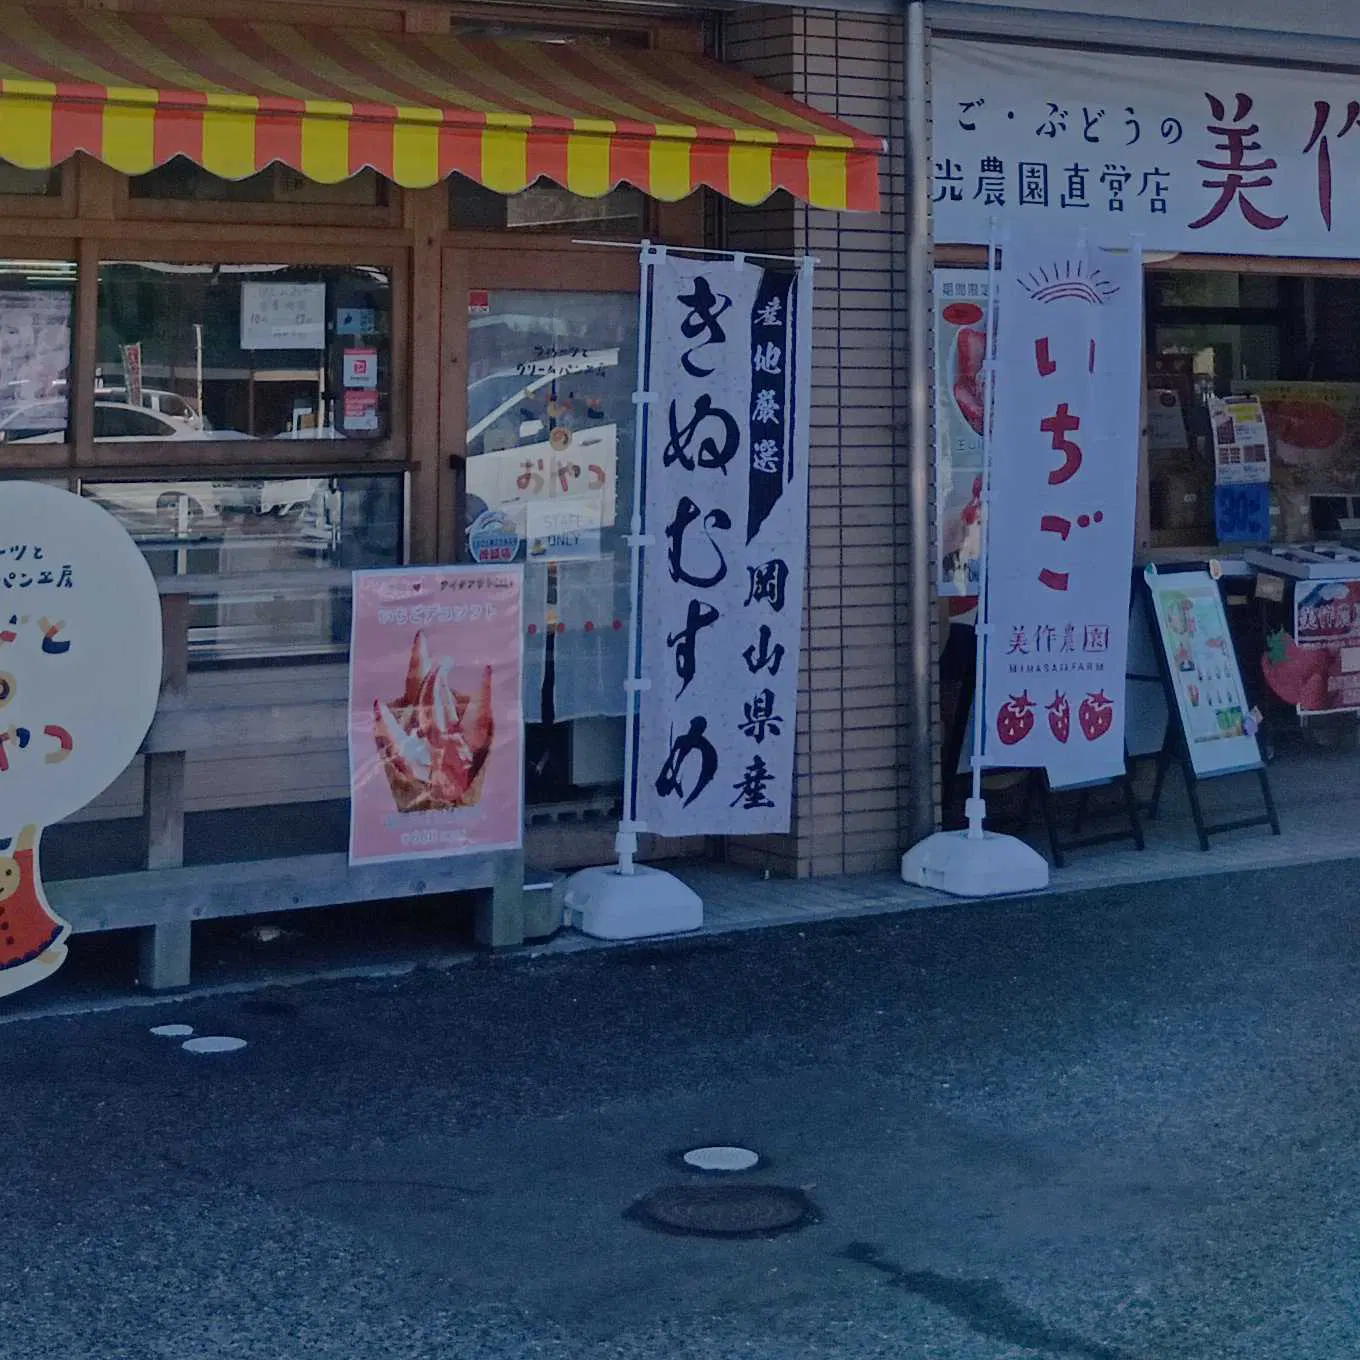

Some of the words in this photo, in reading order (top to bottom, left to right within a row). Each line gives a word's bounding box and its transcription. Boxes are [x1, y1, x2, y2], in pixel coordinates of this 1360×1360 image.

[655, 276, 740, 809] きぬむすめ
[1034, 336, 1104, 593] いちご
[729, 557, 788, 810] 岡山県産
